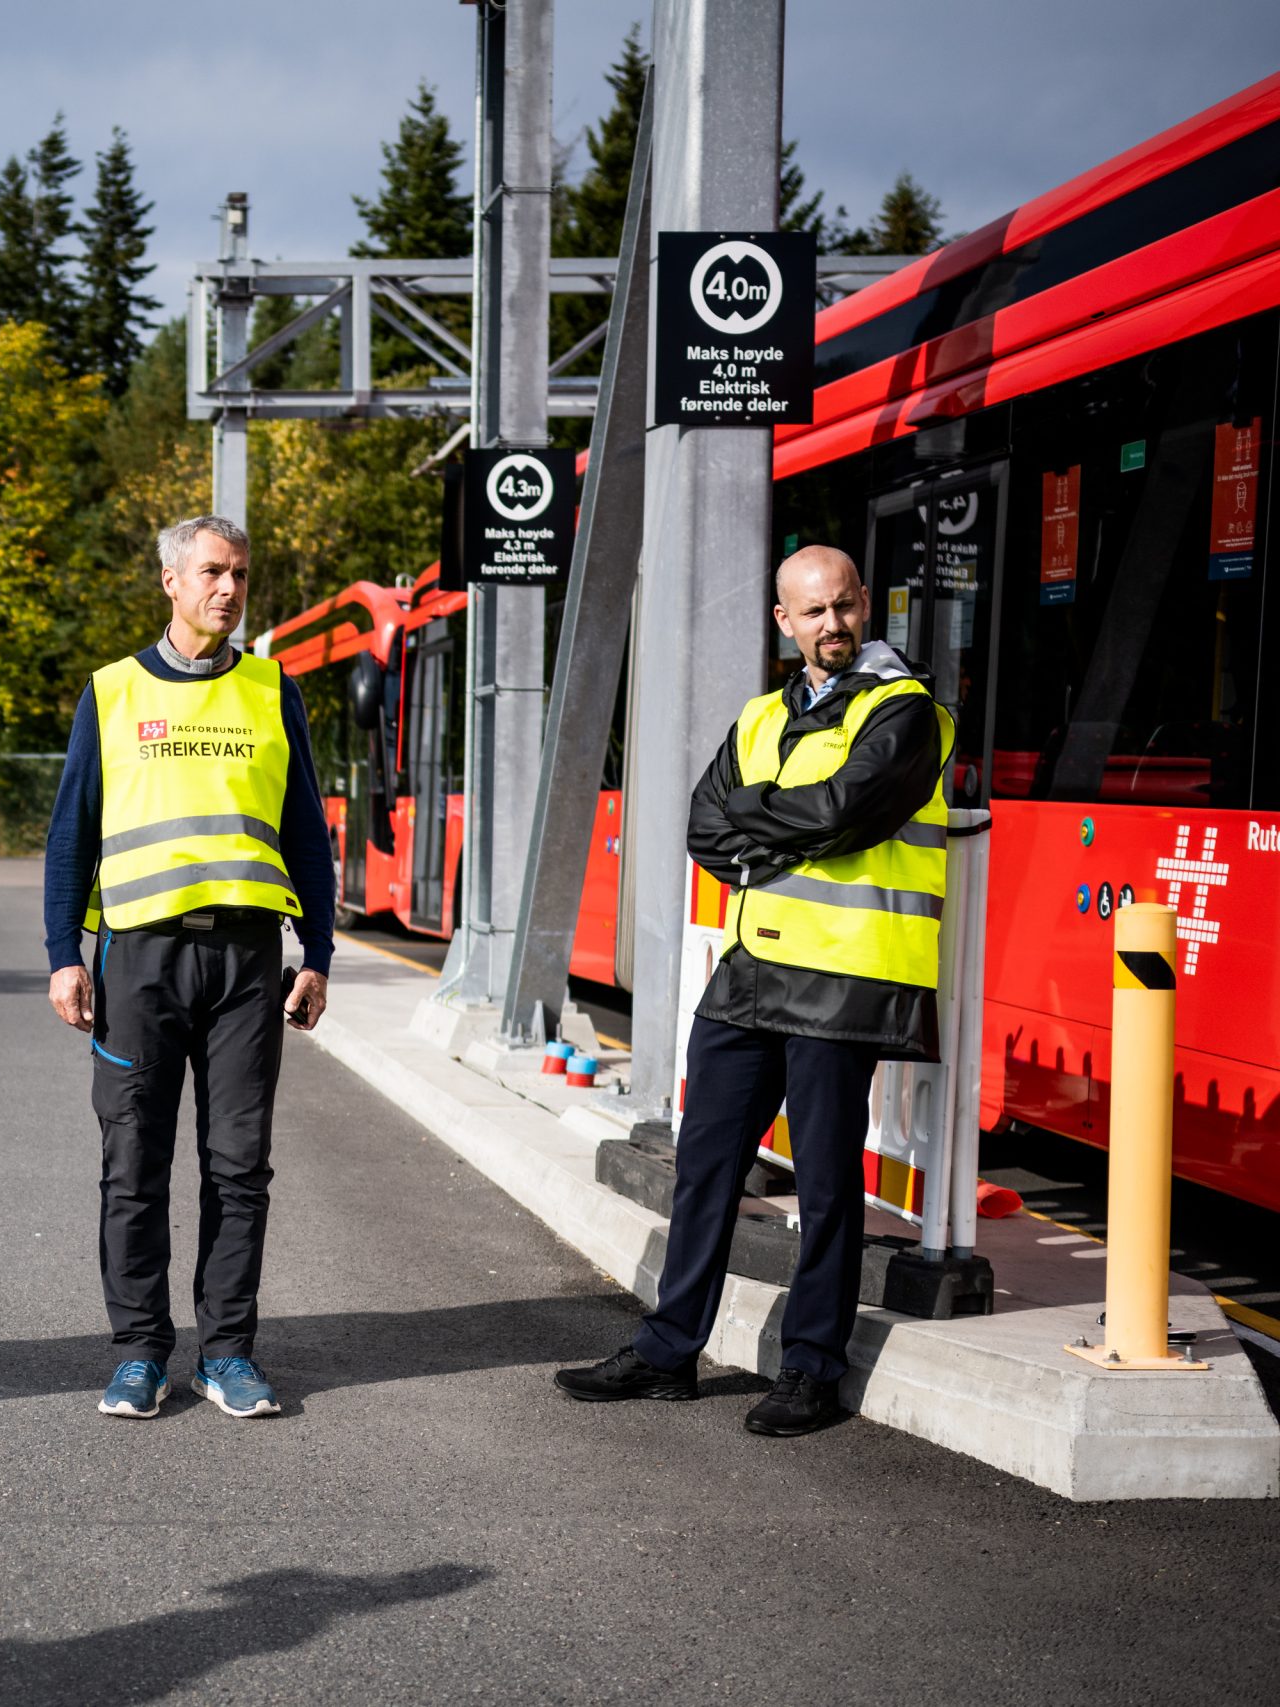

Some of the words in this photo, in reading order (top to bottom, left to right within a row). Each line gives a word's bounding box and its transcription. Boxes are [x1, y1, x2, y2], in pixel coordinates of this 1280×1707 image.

[705, 270, 768, 302] 4,0m
[687, 345, 729, 361] Maks
[733, 346, 785, 364] høyde
[712, 363, 737, 380] 4,0
[741, 366, 757, 378] m
[698, 380, 771, 395] Elektrisk
[680, 397, 743, 412] førende
[747, 397, 790, 412] deler
[484, 527, 516, 539] Maks
[517, 527, 555, 541] høyde
[523, 541, 536, 551] m
[493, 551, 546, 563] Elektrisk
[481, 563, 526, 575] førende
[527, 563, 559, 575] deler
[172, 725, 253, 735] FAGFORBUNDET
[139, 741, 255, 761] STREIKEVAKT
